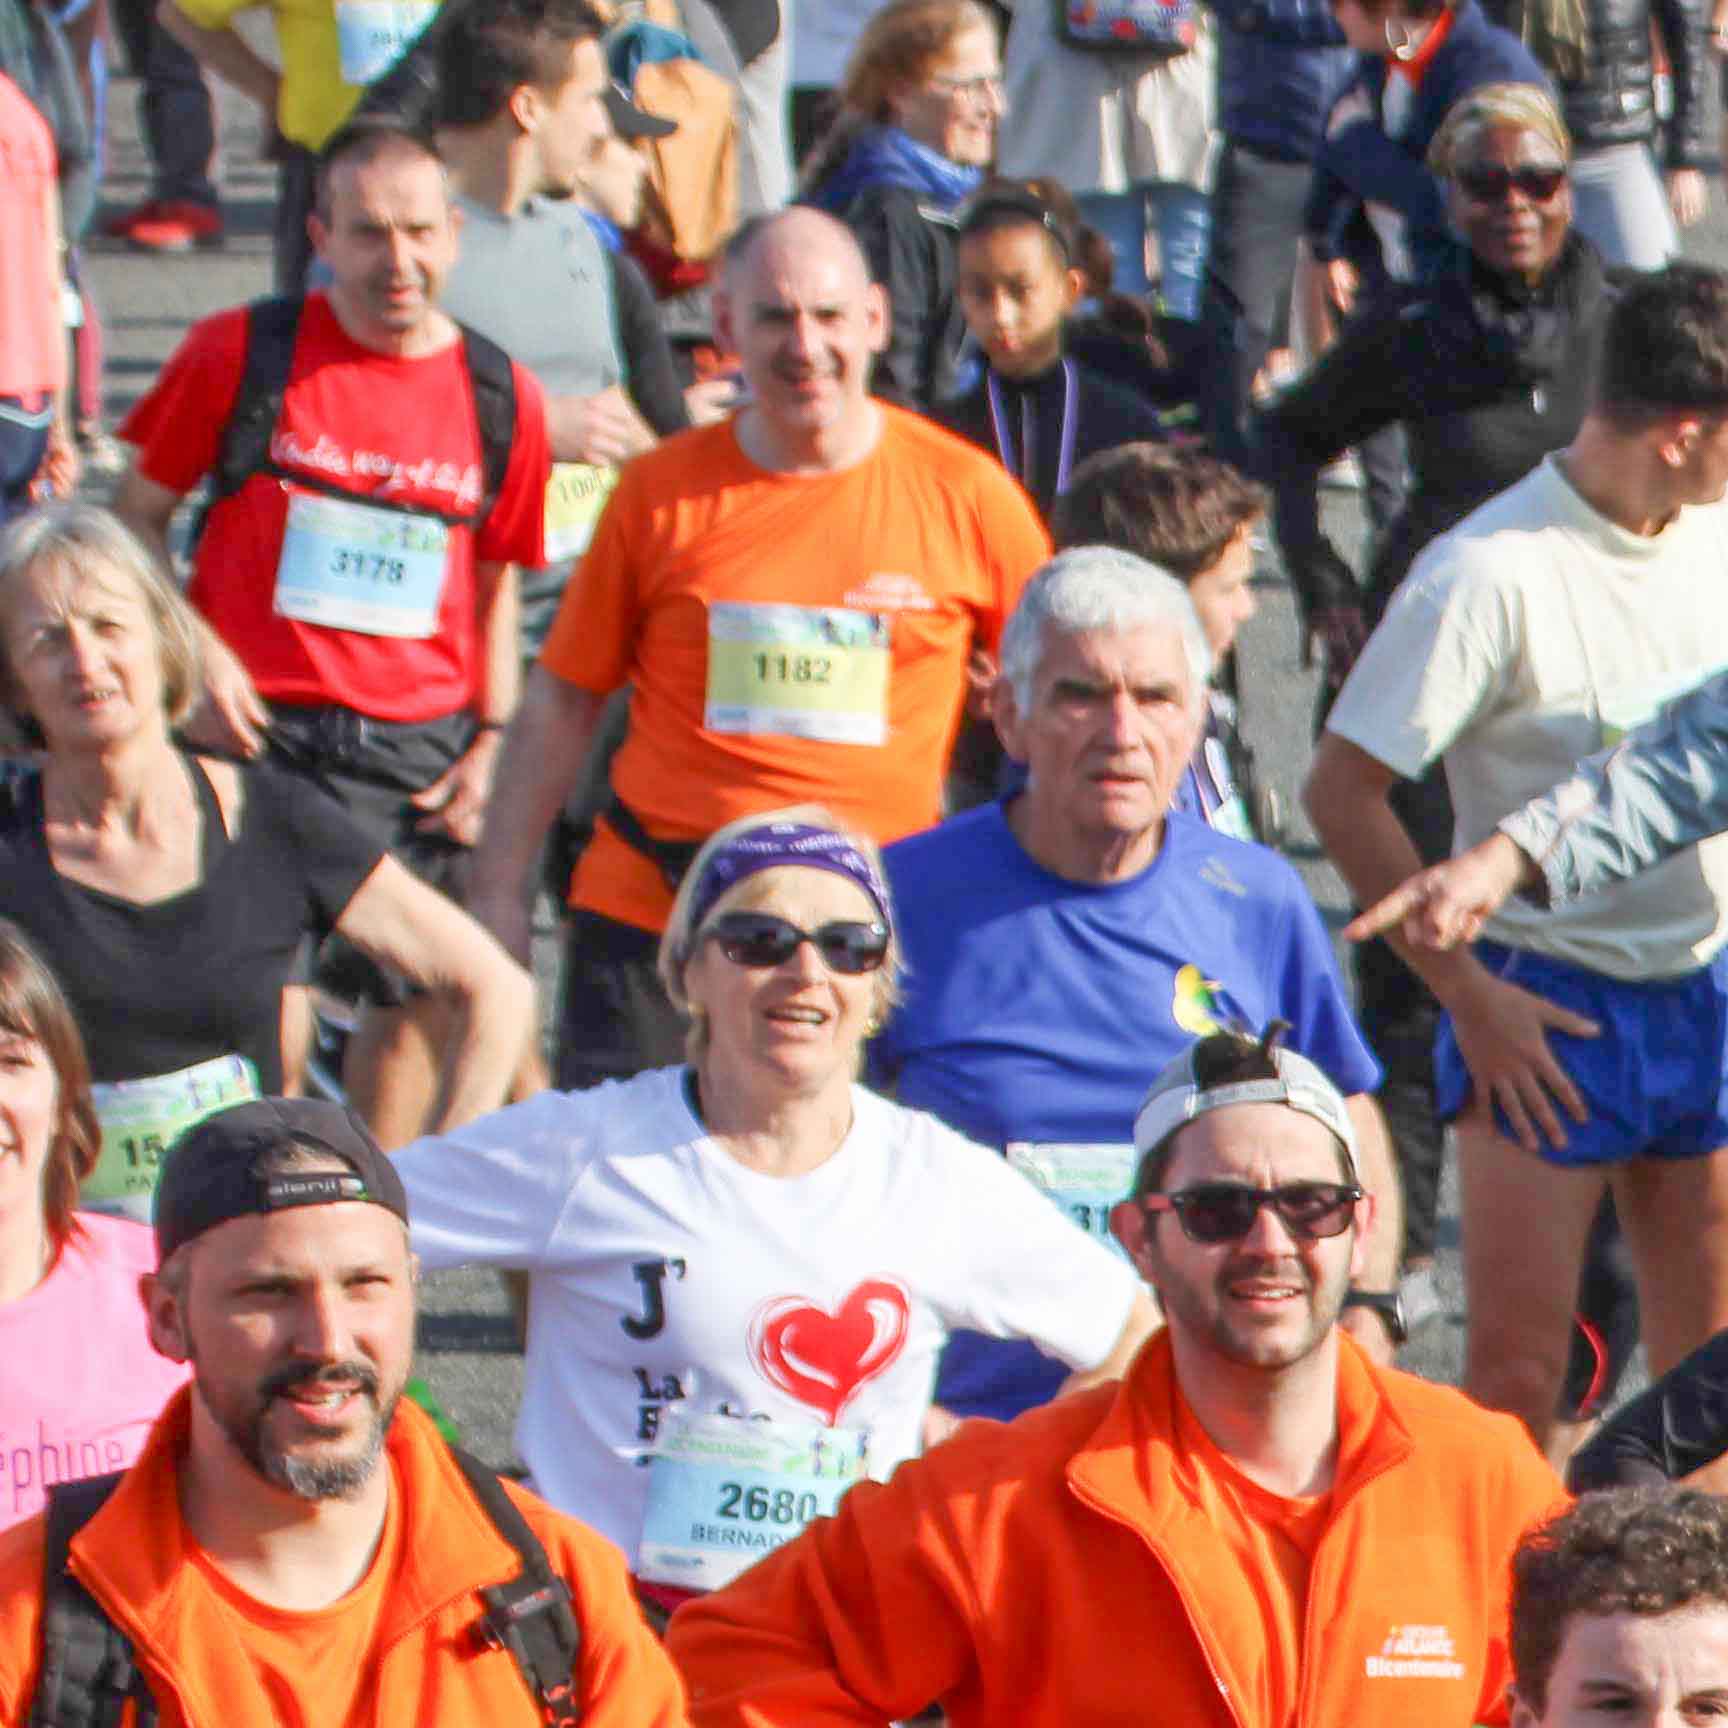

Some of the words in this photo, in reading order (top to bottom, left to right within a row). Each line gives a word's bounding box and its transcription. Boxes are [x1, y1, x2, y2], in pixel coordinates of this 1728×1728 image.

[329, 549, 406, 585] 3178
[753, 652, 832, 684] 1182
[633, 1366, 685, 1402] La
[717, 1481, 818, 1525] 2680
